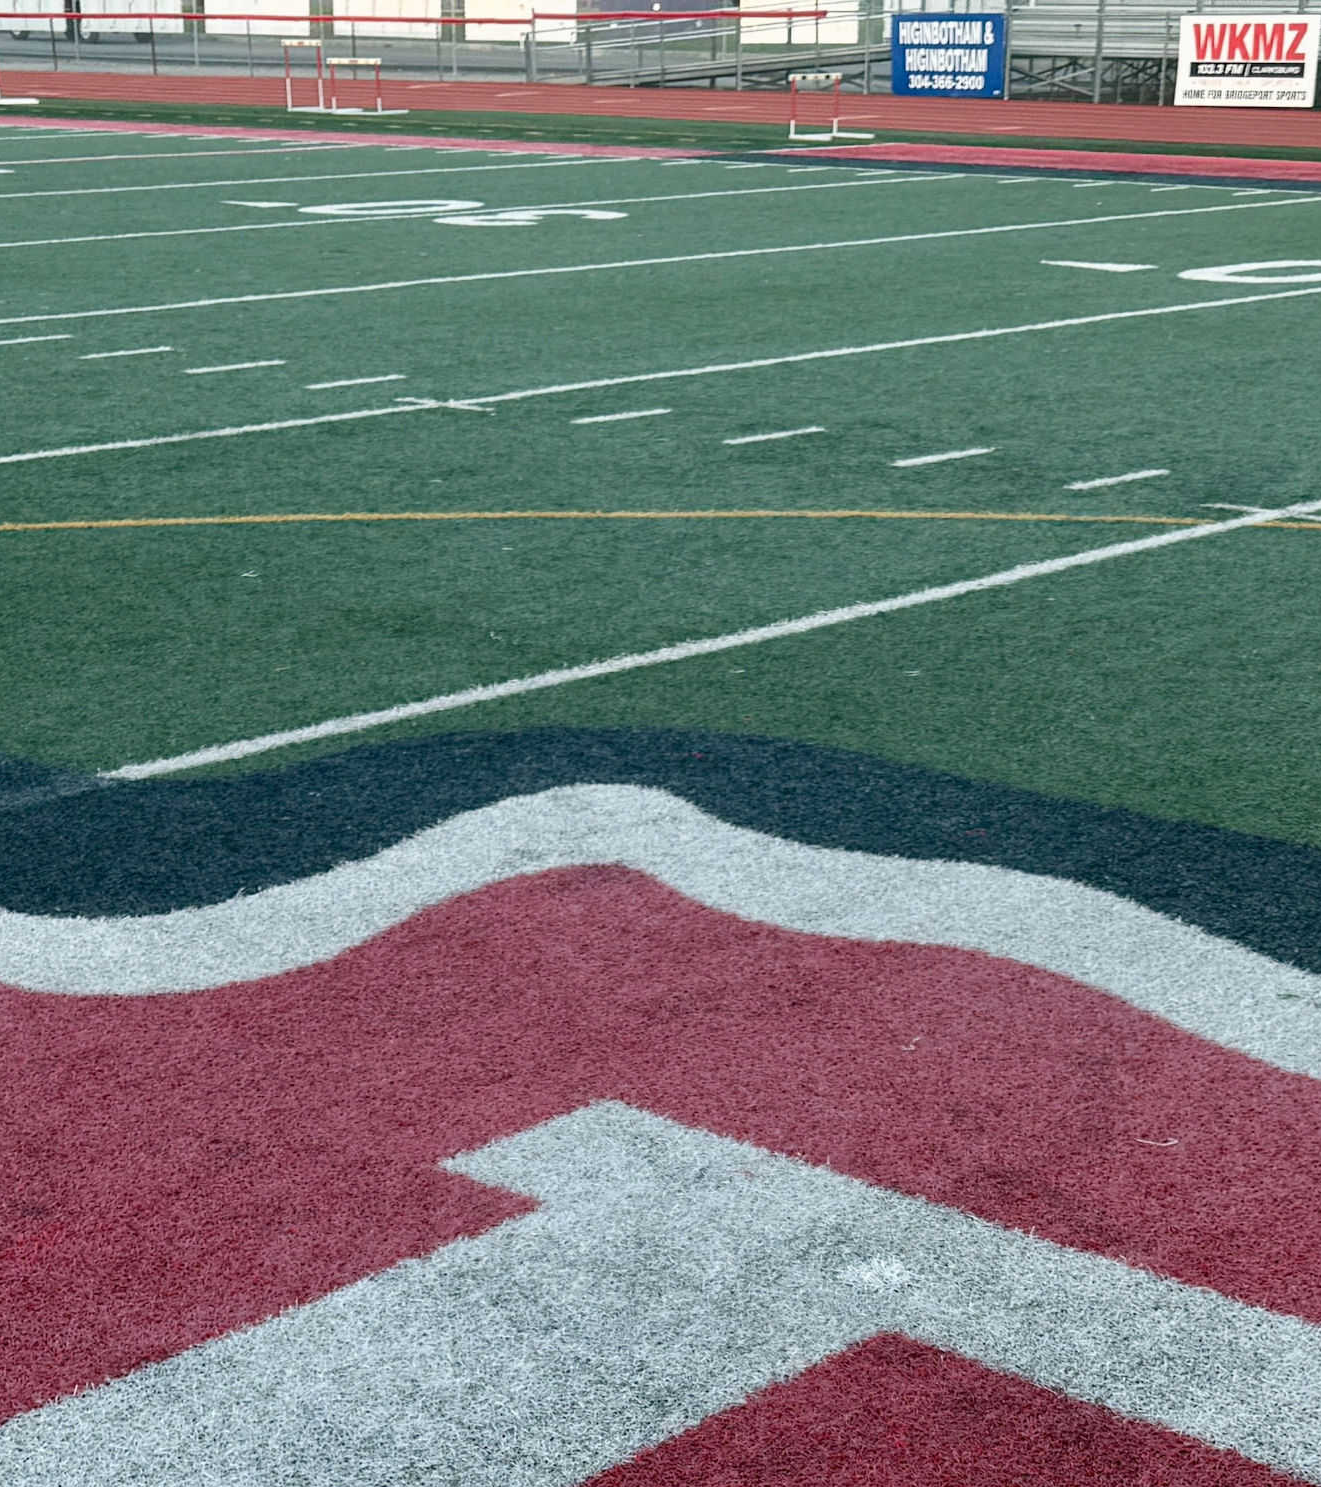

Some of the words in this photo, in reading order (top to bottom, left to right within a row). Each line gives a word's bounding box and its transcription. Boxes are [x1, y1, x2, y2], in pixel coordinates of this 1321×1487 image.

[899, 21, 982, 45] HIGINBOTHAM
[983, 21, 995, 45] &
[1193, 23, 1308, 60] WKMZ
[905, 48, 988, 72] HIGINBOTHAM
[1225, 64, 1244, 75] FM
[1183, 89, 1205, 99] HOME
[1207, 90, 1222, 99] FOR
[1225, 90, 1273, 100] BRIDGEPORT
[1276, 91, 1307, 101] SPORTS
